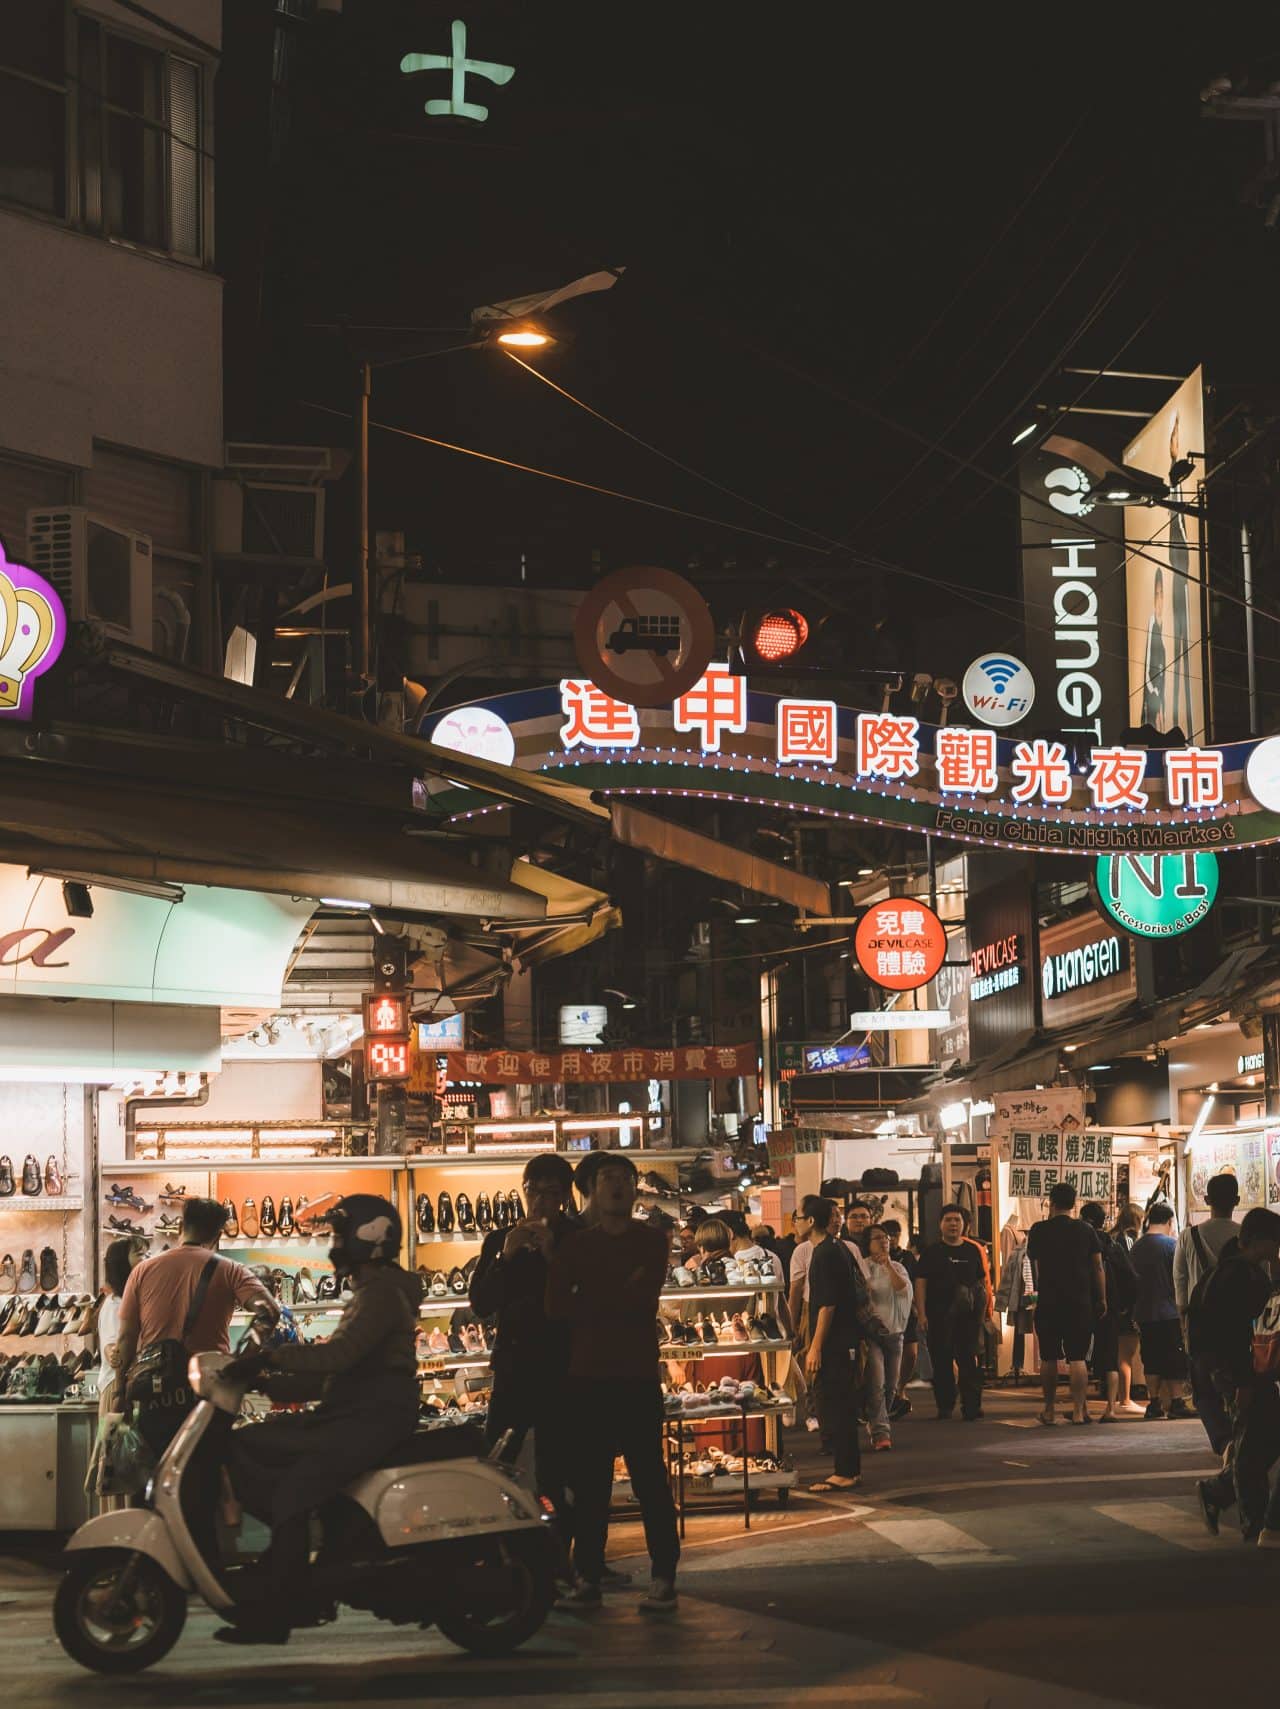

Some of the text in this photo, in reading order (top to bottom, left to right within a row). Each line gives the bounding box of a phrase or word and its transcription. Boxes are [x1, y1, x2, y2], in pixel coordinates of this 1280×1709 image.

[973, 695, 1027, 712] Wi-Fi
[560, 662, 1224, 810] 逢甲國際觀光夜市
[935, 810, 1236, 848] Feng Chia Night Market
[876, 910, 925, 936] 免費
[1111, 899, 1209, 934] Accessories & Bags
[868, 938, 934, 949] DEVILCASE
[971, 933, 1018, 978] DEVILCASE
[876, 951, 926, 976] 體驗
[371, 1043, 405, 1073] 94
[1013, 1132, 1112, 1163] 風螺 燒酒螺
